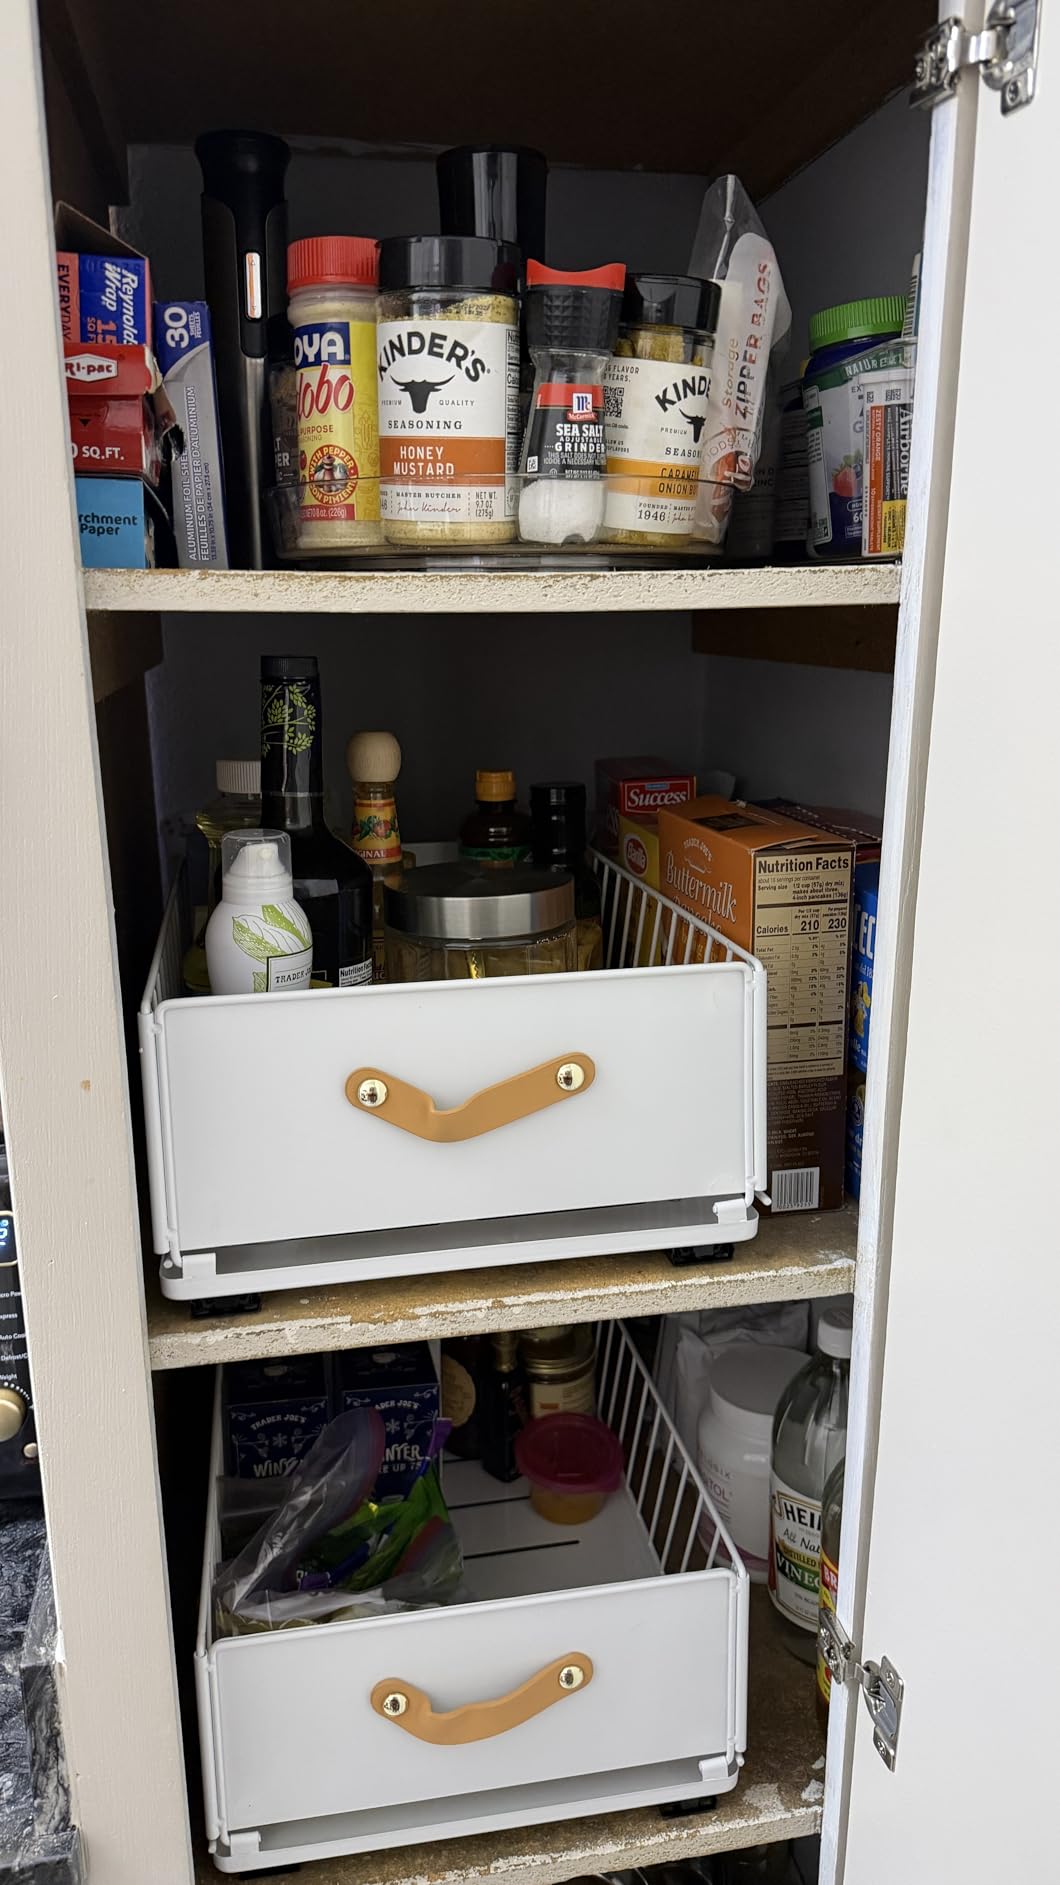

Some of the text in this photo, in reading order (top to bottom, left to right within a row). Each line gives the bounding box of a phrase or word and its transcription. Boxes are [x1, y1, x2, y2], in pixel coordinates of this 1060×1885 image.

[101, 262, 121, 311] Wrap
[164, 306, 189, 348] 30
[734, 263, 771, 421] ZIPPER BAGS
[378, 331, 486, 383] KINDER'S
[613, 365, 639, 374] FLAVOR
[723, 338, 739, 408] Storage
[439, 399, 475, 407] QUALITY
[387, 420, 463, 430] SEASONING
[556, 424, 603, 437] SEA SALT
[660, 427, 688, 435] PREMIUM
[400, 446, 444, 460] HONEY
[899, 407, 914, 495] Airborne
[309, 446, 354, 474] WITH PEPPER
[186, 386, 210, 561] FEUILLES DE PAPIER D'ALUMINIUM
[393, 462, 455, 476] MUSTARD
[183, 477, 192, 501] FOIL
[476, 491, 486, 500] NET
[658, 482, 687, 495] ONION
[637, 509, 666, 522] 1946
[80, 524, 120, 536] Paper
[184, 504, 197, 561] ALUMINUM
[627, 788, 687, 808] Success
[758, 856, 849, 874] Nutrition Facts
[666, 850, 737, 923] Buttermilk
[756, 917, 847, 934] Calories 210 230
[274, 970, 304, 984] TRADER
[340, 964, 363, 977] Nutrition
[397, 1399, 420, 1409] JOE'S
[250, 1414, 307, 1431] TRADER JOE'S
[382, 1443, 425, 1462] NTER
[783, 1527, 796, 1544] All
